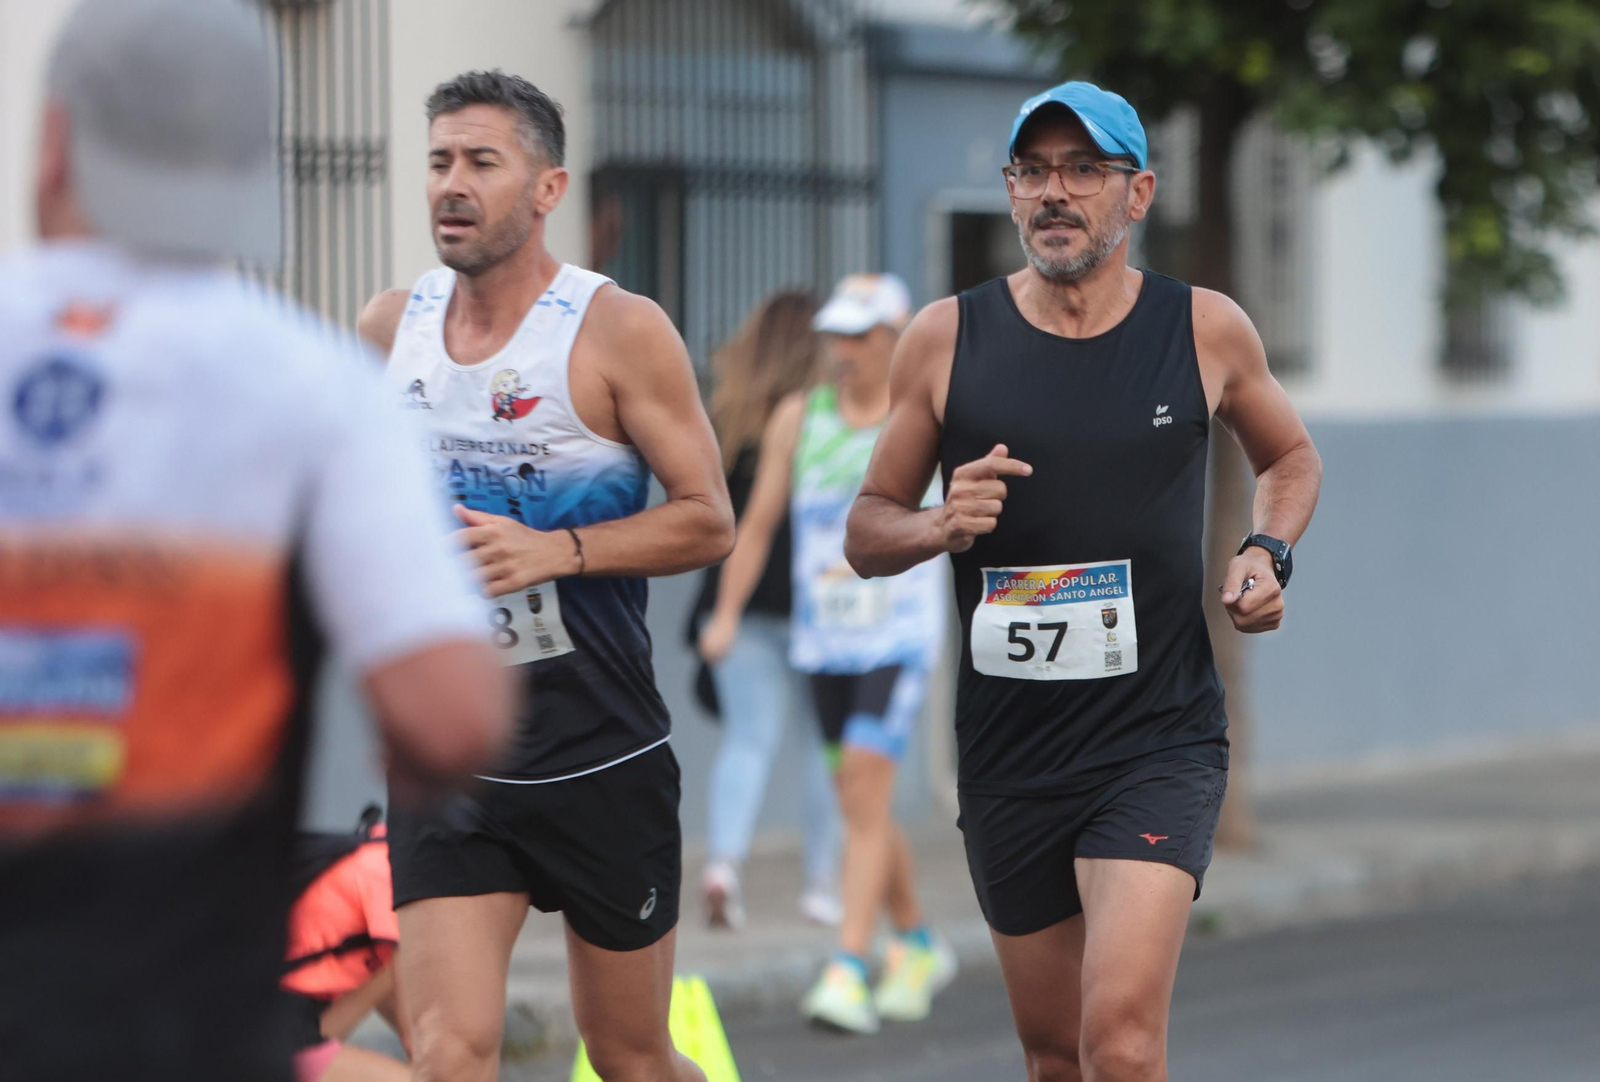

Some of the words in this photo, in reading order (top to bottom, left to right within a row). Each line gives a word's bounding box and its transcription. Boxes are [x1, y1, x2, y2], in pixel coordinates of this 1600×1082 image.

[1152, 415, 1173, 428] ipso
[995, 577, 1047, 590] CARRERA
[1050, 572, 1118, 589] POPULAR
[1049, 589, 1087, 602] SANTO
[1089, 585, 1125, 598] ANGEL
[1007, 621, 1068, 663] 57
